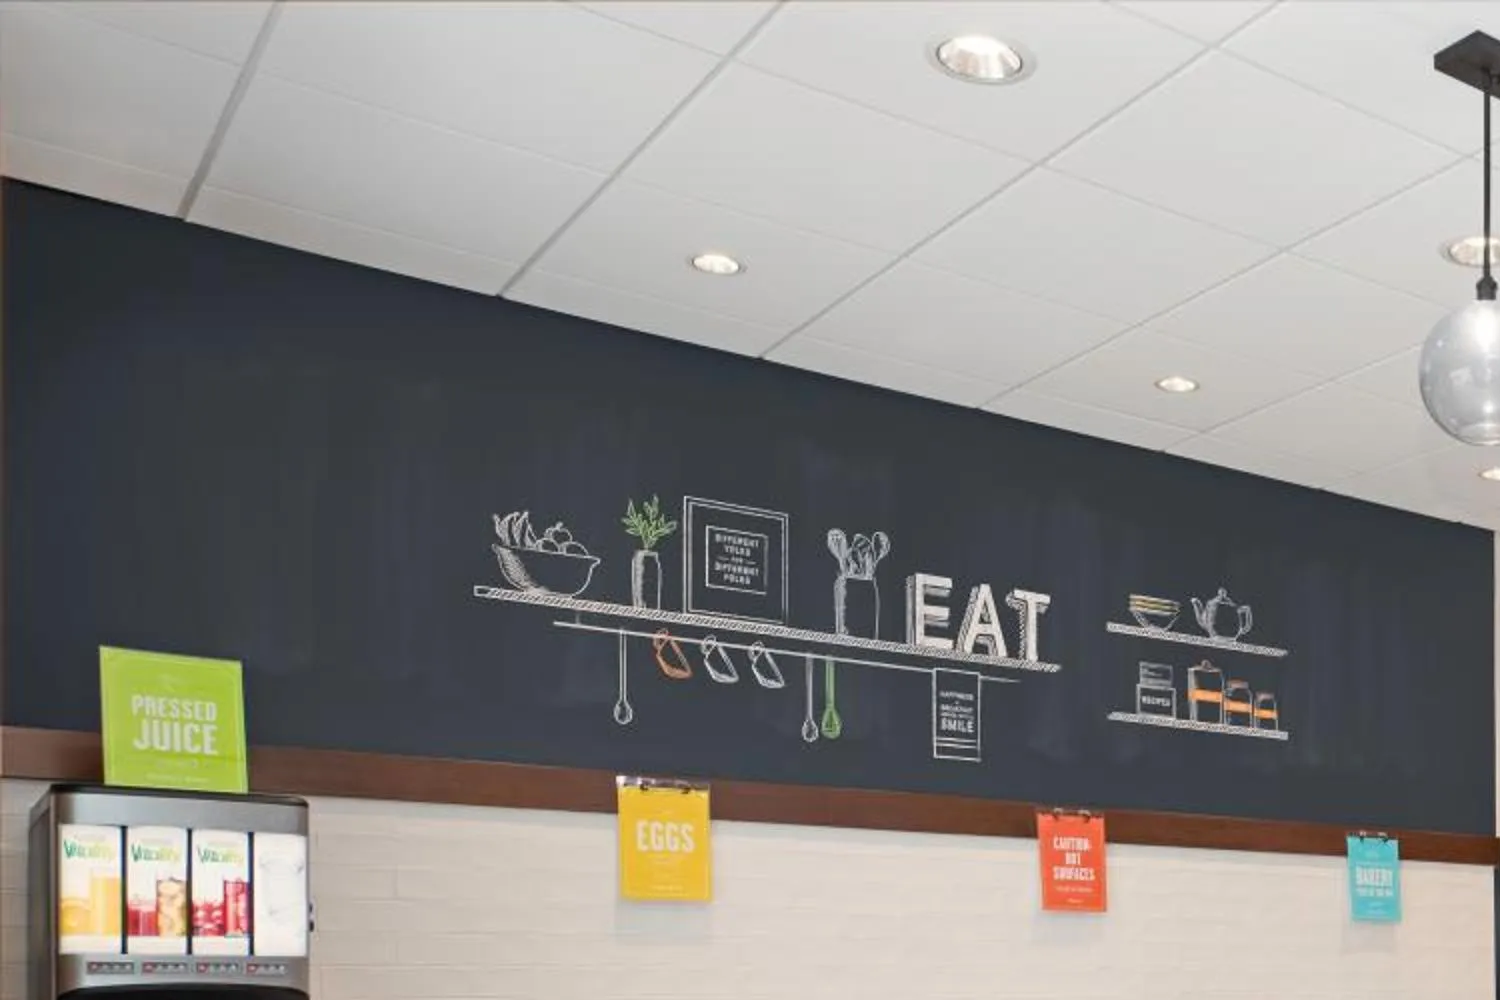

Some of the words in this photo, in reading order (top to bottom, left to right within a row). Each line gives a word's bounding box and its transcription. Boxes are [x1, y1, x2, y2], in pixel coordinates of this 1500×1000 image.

[906, 573, 1050, 661] EAT
[131, 693, 218, 722] PRESSED
[941, 717, 975, 733] SMILE
[133, 719, 218, 756] JUICE
[636, 818, 697, 853] EGGS
